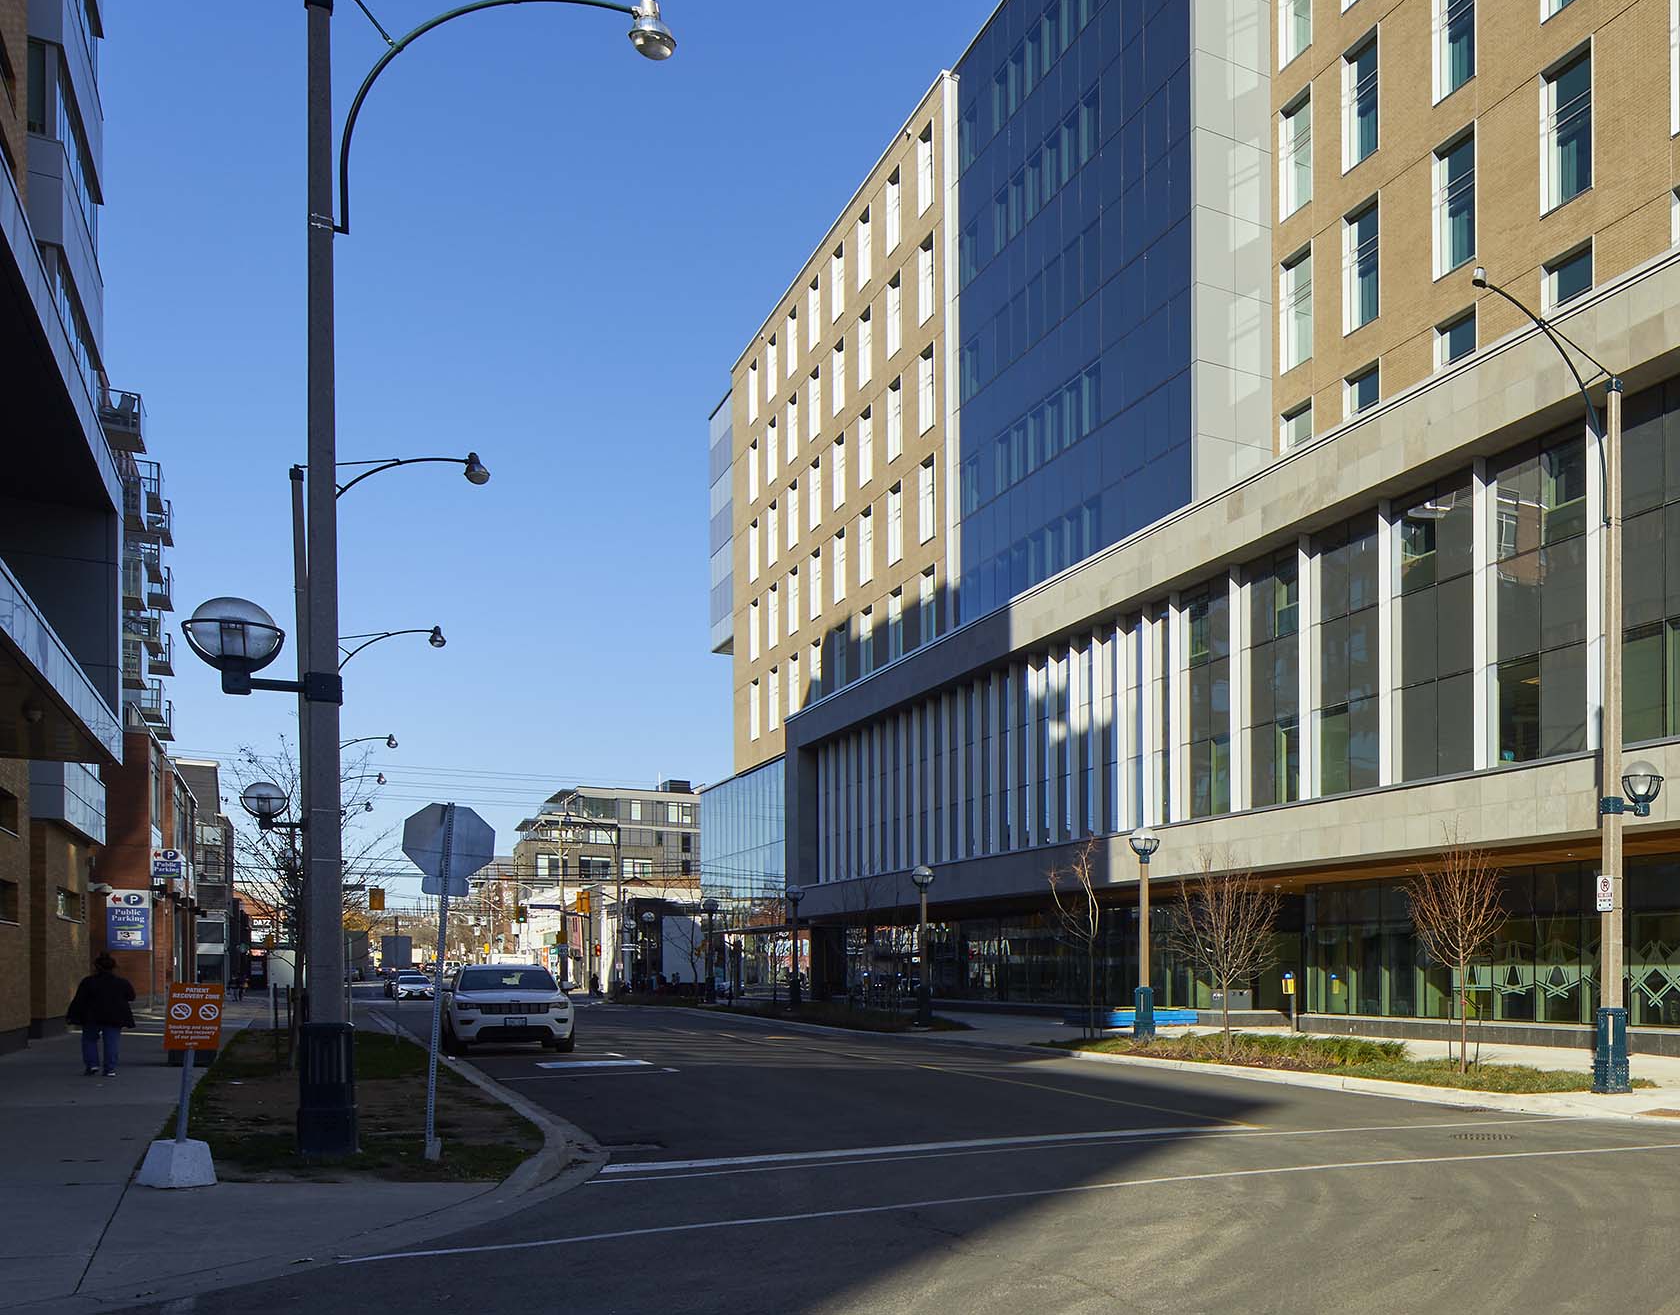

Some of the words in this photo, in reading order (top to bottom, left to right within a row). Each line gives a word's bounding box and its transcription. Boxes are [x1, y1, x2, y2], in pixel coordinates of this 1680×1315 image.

[167, 851, 175, 859] P
[130, 896, 139, 904] P
[114, 908, 142, 916] Public
[111, 915, 145, 923] Parking
